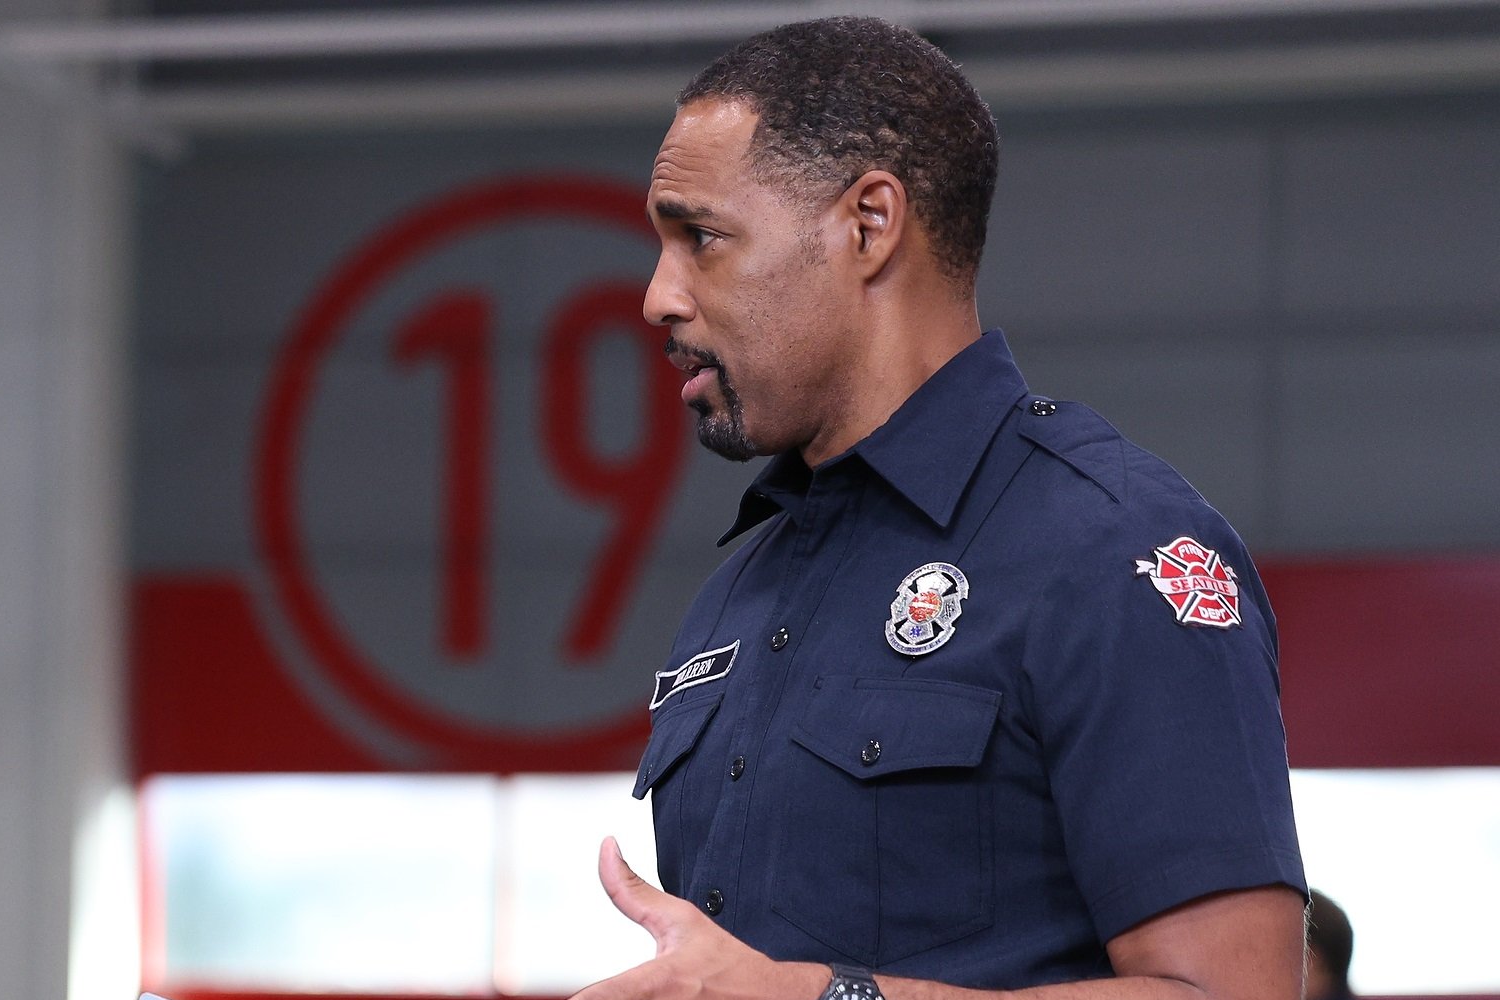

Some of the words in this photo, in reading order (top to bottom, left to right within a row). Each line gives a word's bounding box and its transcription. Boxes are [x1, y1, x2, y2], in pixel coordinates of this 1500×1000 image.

[396, 277, 689, 659] 19
[1170, 578, 1230, 594] SEATTLE
[1198, 605, 1227, 619] DEPT
